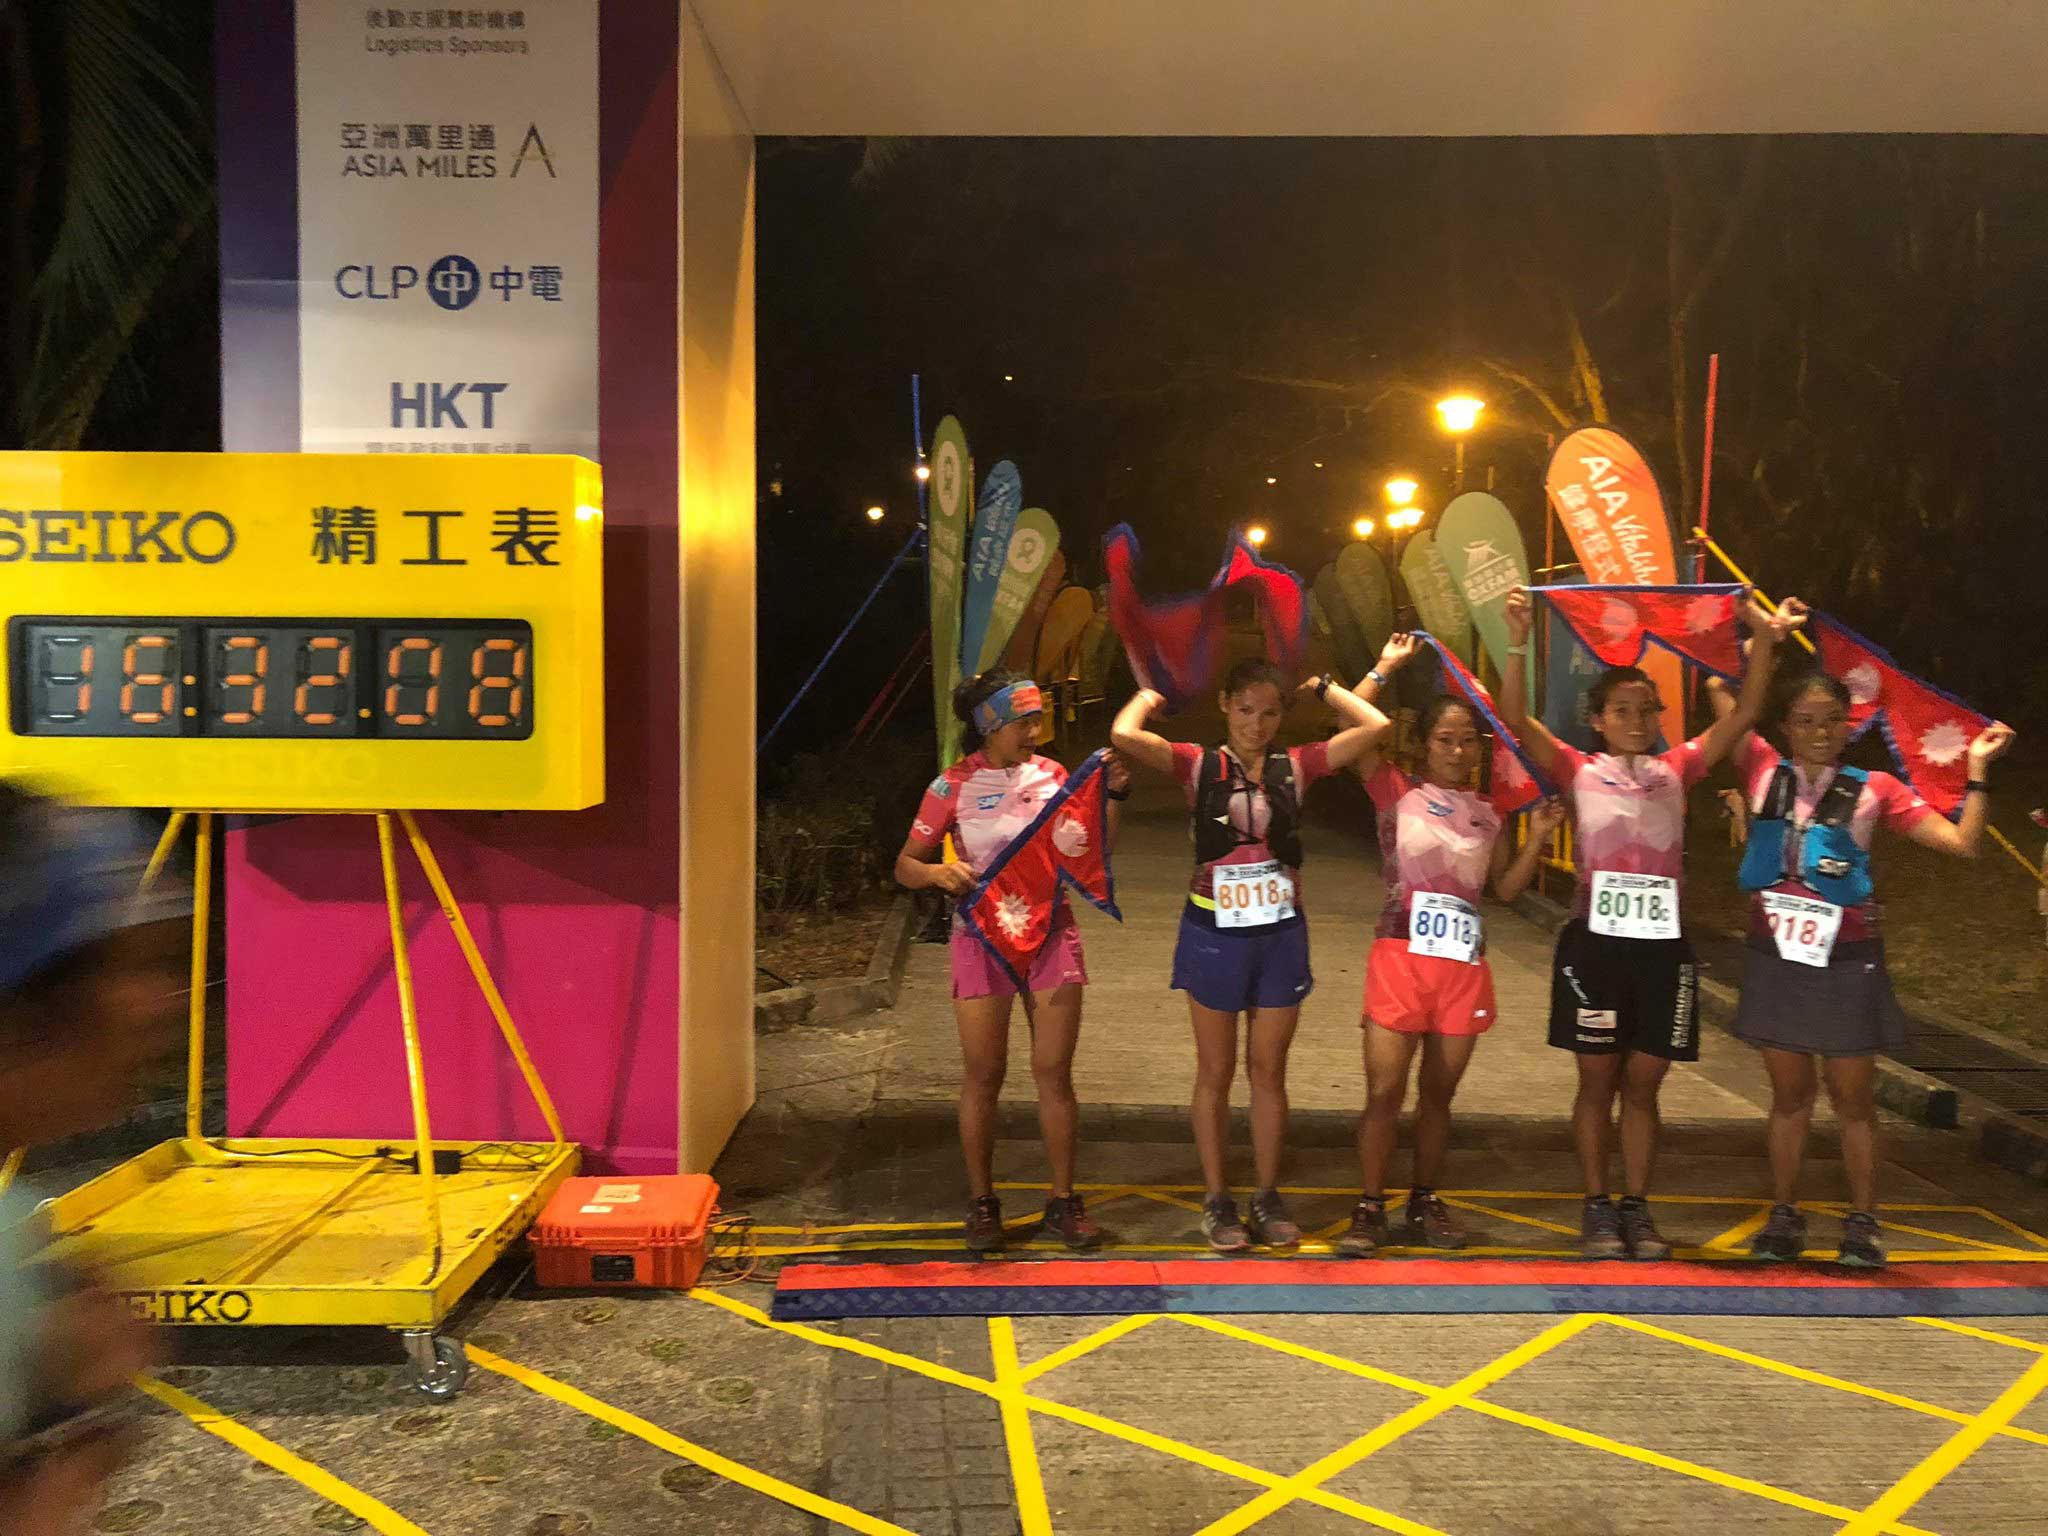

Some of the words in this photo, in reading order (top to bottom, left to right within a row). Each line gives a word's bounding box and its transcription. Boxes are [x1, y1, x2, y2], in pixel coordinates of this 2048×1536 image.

[449, 35, 530, 56] Sponsors
[340, 123, 496, 150] 亞洲萬里通
[341, 153, 408, 178] ASIA
[416, 153, 497, 178] MILES
[334, 264, 419, 300] CLP
[489, 264, 564, 302] 中電
[389, 381, 510, 430] HKT
[1579, 456, 1630, 516] AIA
[311, 506, 562, 566] 精工表
[118, 1290, 253, 1323] EIKO
